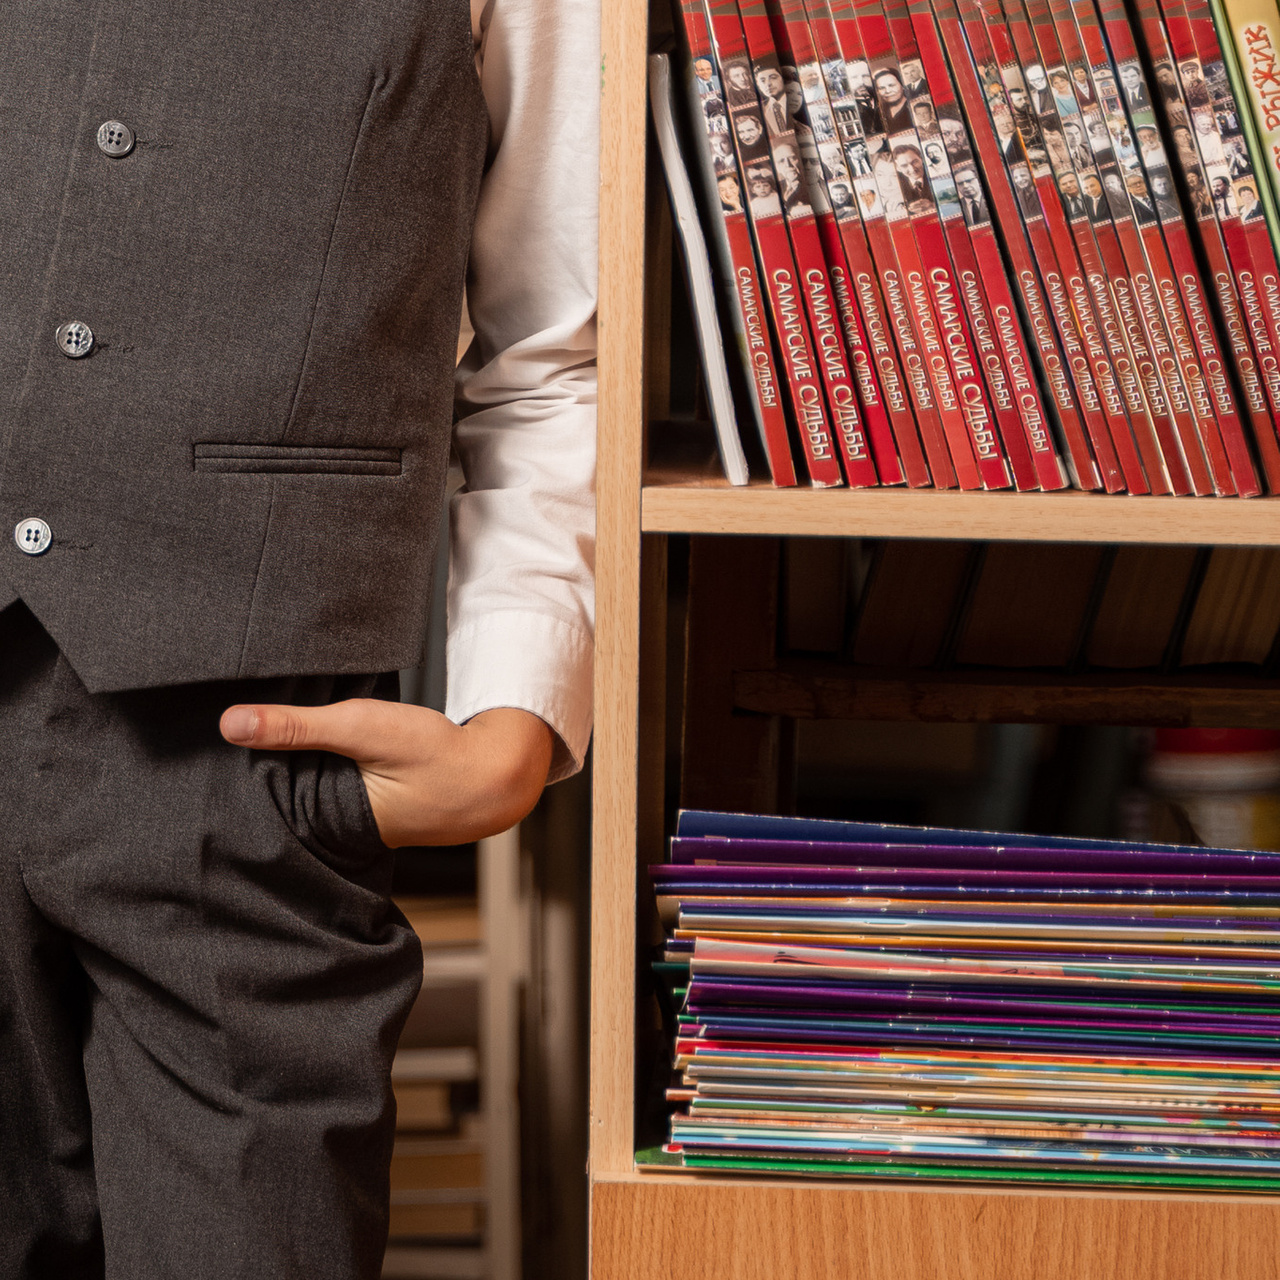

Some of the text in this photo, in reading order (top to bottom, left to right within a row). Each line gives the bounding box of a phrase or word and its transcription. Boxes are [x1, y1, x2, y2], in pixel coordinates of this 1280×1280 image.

[1244, 24, 1280, 132] РЫЖИК
[737, 266, 778, 408] САМАРСКИЕ СУДЬБЫ
[773, 268, 832, 461] САМАРСКИЕ СУДЬБЫ
[806, 268, 867, 461] САМАРСКИЕ СУДЬБЫ
[830, 266, 879, 406] САМАРСКИЕ СУДЬБЫ
[856, 272, 907, 412] САМАРСКИЕ СУДЬБЫ
[883, 270, 933, 410] САМАРСКИЕ СУДЬБЫ
[907, 271, 958, 412] САМАРСКИЕ СУДЬБЫ
[930, 267, 999, 460] САМАРСКИЕ СУДЬБЫ
[961, 270, 1013, 410] САМАРСКИЕ СУДЬБЫ
[995, 305, 1050, 452] САМАРСКИЕ СУДЬБЫ
[1020, 270, 1073, 410] САМАРСКИЕ СУДЬБЫ
[1046, 272, 1100, 412] САМАРСКИЕ СУДЬБЫ
[1069, 276, 1124, 416] САМАРСКИЕ СУДЬБЫ
[1089, 274, 1144, 414] САМАРСКИЕ СУДЬБЫ
[1114, 277, 1168, 417] САМАРСКИЕ СУДЬБЫ
[1135, 273, 1189, 413] САМАРСКИЕ СУДЬБЫ
[1160, 279, 1213, 420] САМАРСКИЕ СУДЬБЫ
[1182, 274, 1235, 415] САМАРСКИЕ СУДЬБЫ
[1215, 272, 1266, 414] САМАРСКИЕ СУДЬБЫ
[1238, 271, 1272, 354] САМАРСКИЕ
